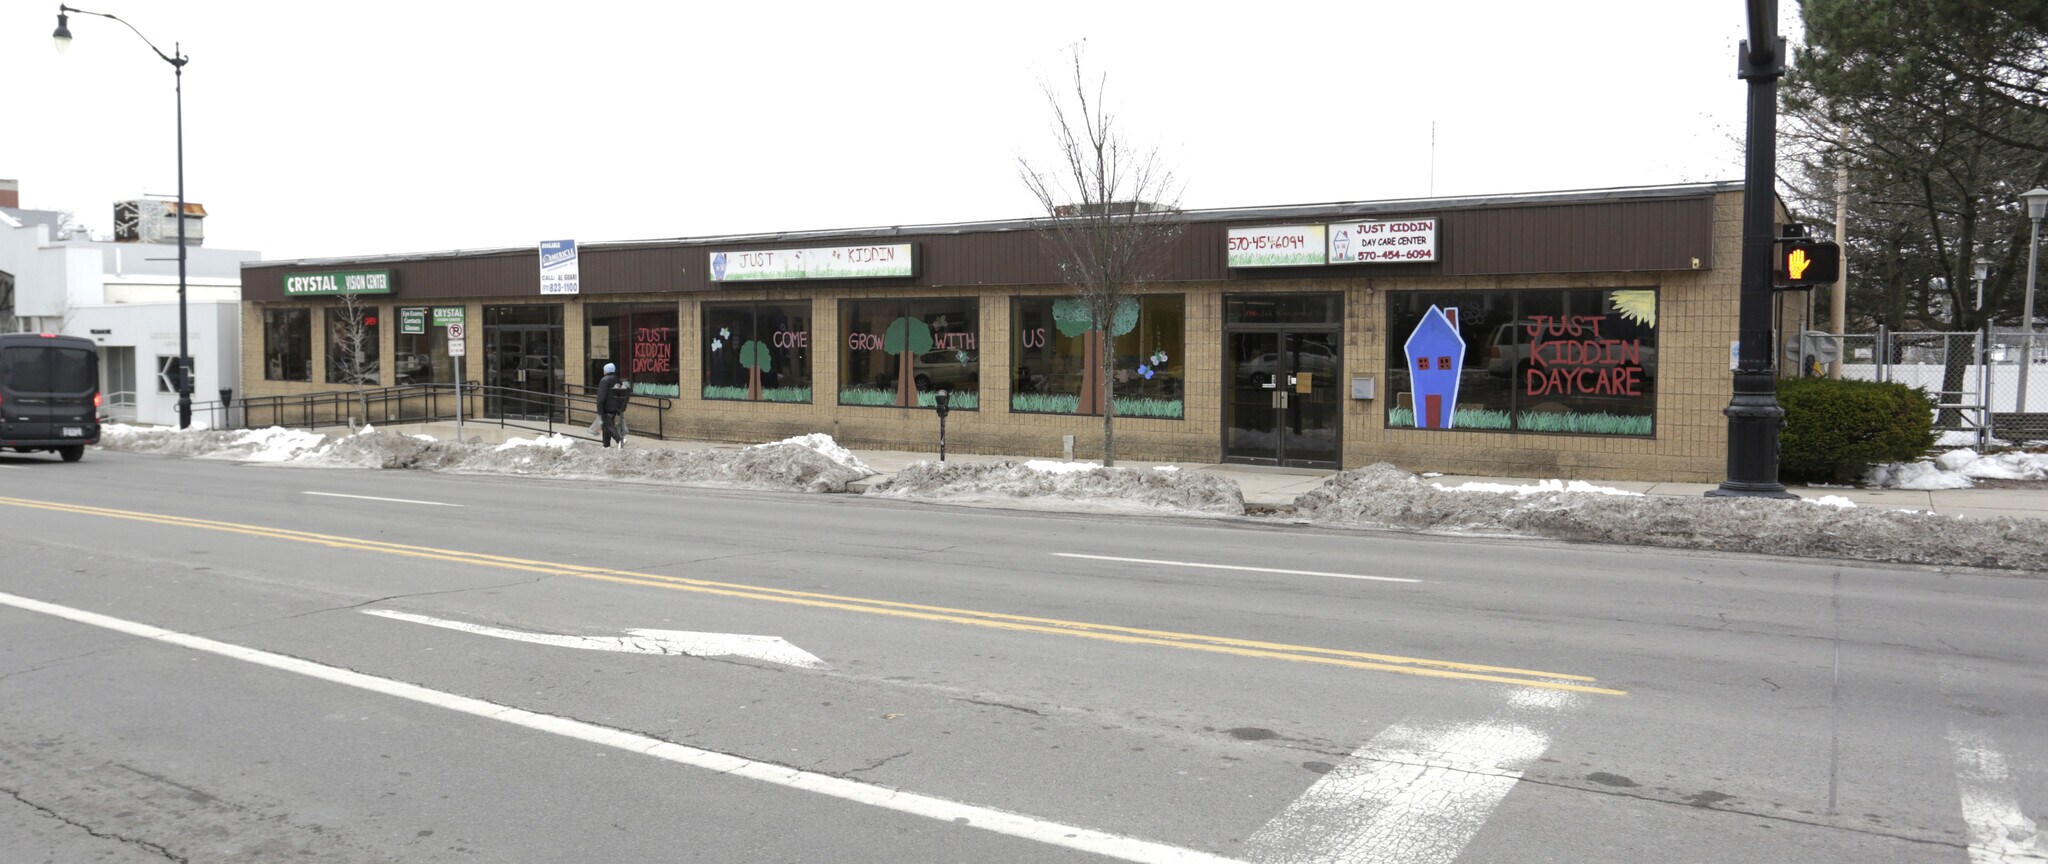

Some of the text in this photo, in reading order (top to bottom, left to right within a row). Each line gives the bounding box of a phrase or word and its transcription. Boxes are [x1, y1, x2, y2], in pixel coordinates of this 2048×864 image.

[1357, 222, 1433, 234] JUST KIDDIN
[1361, 236, 1427, 247] DAY CARE CENTER
[739, 247, 895, 269] JUST KIDDIN
[1357, 249, 1432, 260] 570-454-6094
[287, 273, 387, 292] CRYSTAL VISION CENTER
[433, 308, 463, 317] CRYSTAL
[1526, 314, 1607, 338] JUST
[638, 327, 672, 342] JUST
[773, 328, 1046, 350] COME GROW WITH US
[634, 343, 671, 358] KIDDIN
[1528, 339, 1640, 367] KIDDIN
[632, 358, 671, 373] DAYCARE
[1526, 366, 1642, 396] DAYCARE
